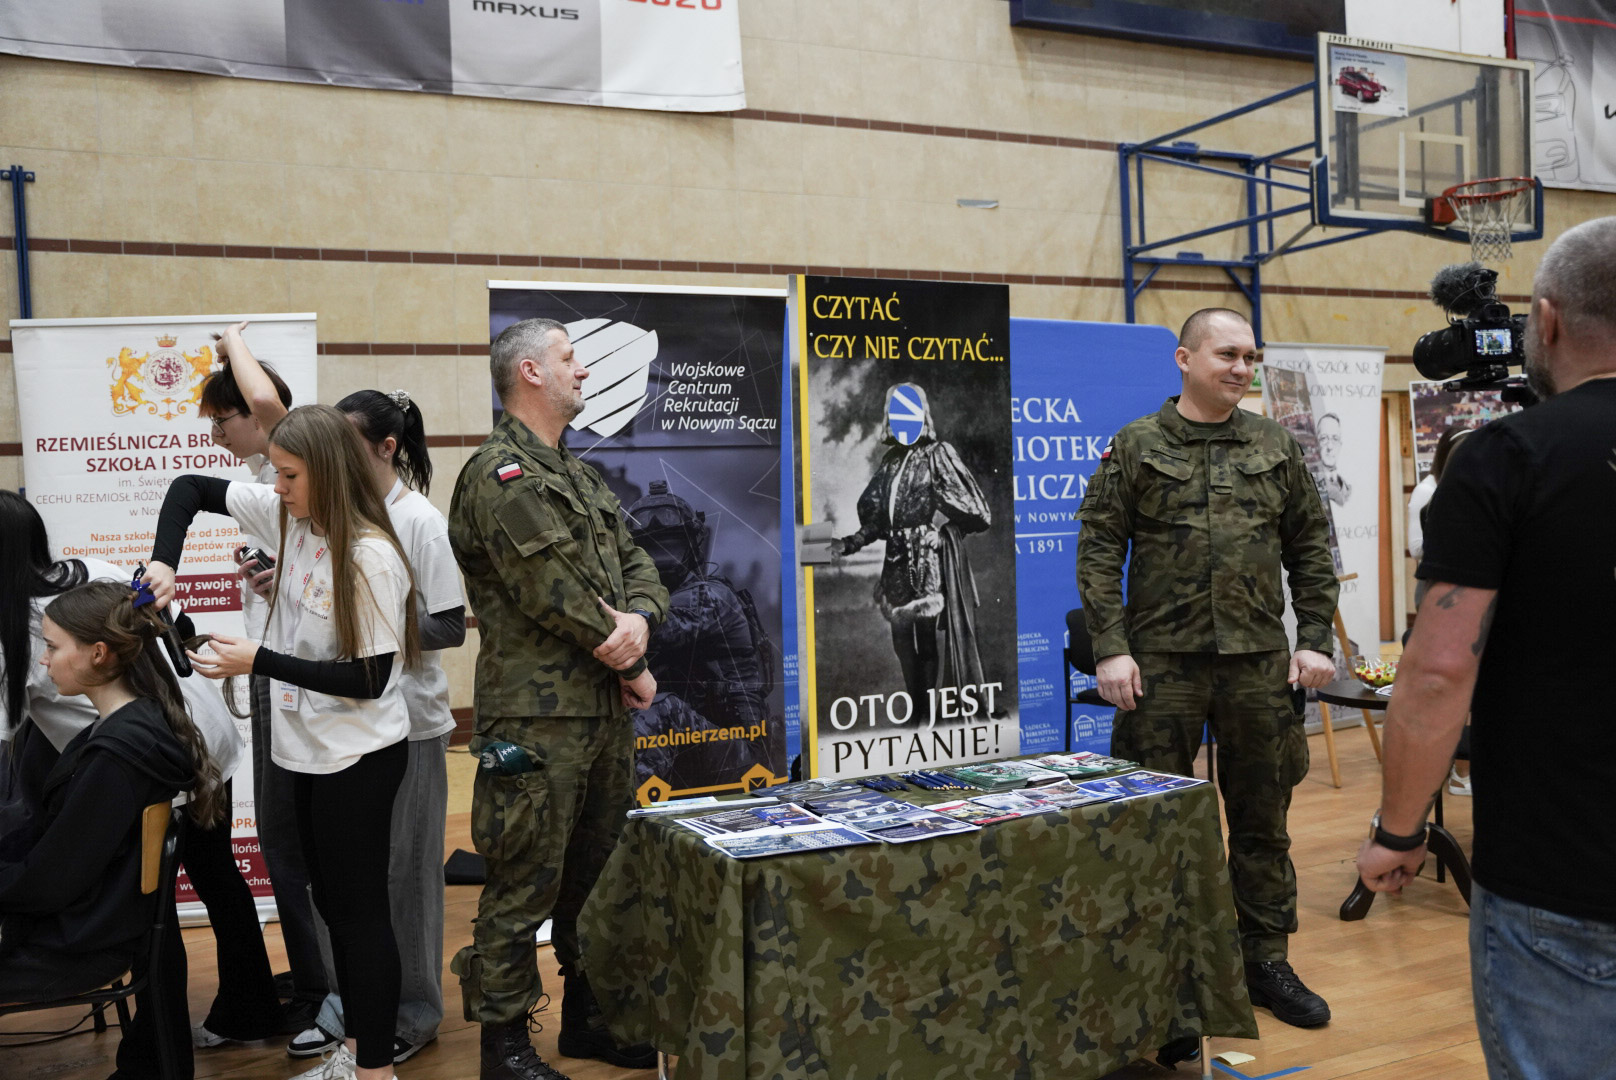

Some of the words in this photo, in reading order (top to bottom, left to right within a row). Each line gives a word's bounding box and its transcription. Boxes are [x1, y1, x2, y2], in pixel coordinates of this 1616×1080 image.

[1328, 34, 1352, 44] SPORT
[812, 291, 900, 321] CZYTAĆ
[814, 334, 857, 359] CZY
[865, 336, 900, 360] NIE
[907, 332, 1004, 362] CZYTAĆ...
[671, 361, 745, 380] Wojskowe
[1316, 359, 1352, 374] SZKÓŁ
[1355, 361, 1370, 374] NR
[1374, 362, 1380, 376] 3
[668, 380, 732, 395] Centrum
[663, 396, 740, 416] Rekrutacji
[661, 419, 675, 430] w
[677, 416, 734, 433] Nowym
[737, 415, 777, 433] Sączu
[36, 432, 182, 453] RZEMIEŚLNICZA
[188, 433, 215, 448] BR
[86, 456, 157, 473] SZKOŁA
[162, 455, 167, 470] I
[118, 478, 135, 488] im.
[36, 494, 72, 505] CECHU
[76, 492, 131, 504] RZEMIOSŁ
[90, 533, 122, 543] Nasza
[124, 531, 156, 541] szkoła
[199, 528, 212, 538] od
[215, 527, 239, 537] 1993
[62, 545, 116, 557] Obejmuje
[182, 541, 224, 552] deptów
[1029, 538, 1063, 554] 1891
[195, 578, 232, 592] swoje
[829, 690, 914, 731] OTO
[926, 681, 1003, 732] JEST
[634, 719, 767, 750] nzolnierzem.pl
[831, 723, 1000, 774] PYTANIE!
